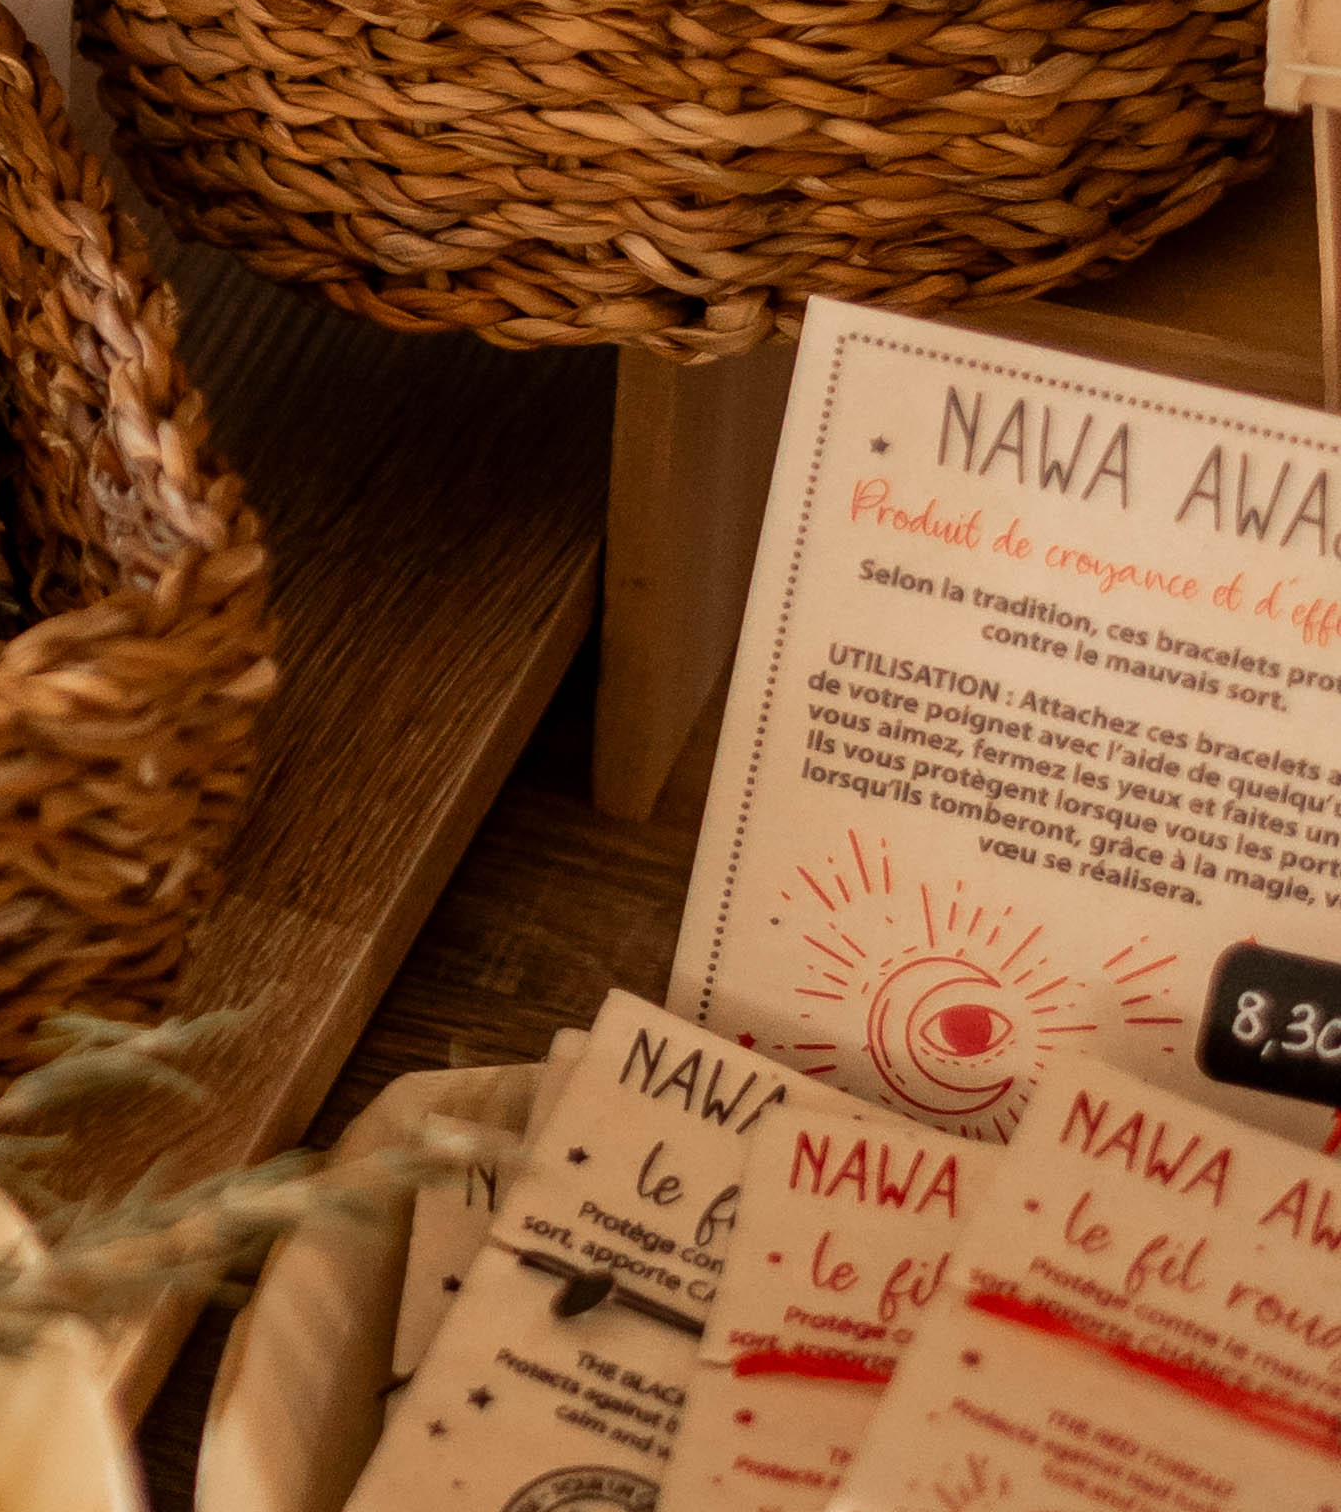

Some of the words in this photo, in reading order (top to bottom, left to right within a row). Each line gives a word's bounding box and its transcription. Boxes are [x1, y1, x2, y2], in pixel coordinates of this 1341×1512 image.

[936, 384, 1131, 511] NAWA
[849, 477, 984, 553] Produit
[990, 516, 1033, 560] de
[1043, 543, 1199, 601] croyance
[1211, 570, 1245, 612] et
[857, 557, 935, 596] Selon
[940, 575, 966, 604] la
[971, 586, 1099, 638] tradition,
[1105, 623, 1149, 648] ces
[1154, 628, 1281, 680] bracelets
[980, 623, 1069, 660] contre
[1073, 639, 1100, 667] le
[1103, 653, 1220, 696] mauvais
[1225, 682, 1288, 713] sort.
[806, 669, 842, 697] de
[847, 681, 920, 715] votre
[923, 701, 1034, 743] poignet
[1036, 728, 1101, 759] avec
[1185, 761, 1222, 789] de
[807, 702, 872, 734] vous
[875, 717, 965, 759] aimez,
[971, 736, 1068, 782] fermez
[1071, 761, 1110, 792] les
[1114, 778, 1183, 810] yeux
[1187, 796, 1217, 818] et
[1221, 798, 1302, 839] faites
[827, 641, 1001, 704] UTILISATION
[1017, 689, 1141, 739] Attachez
[1145, 725, 1189, 750] ces
[1194, 730, 1321, 782] bracelets
[805, 728, 836, 756] Ils
[842, 741, 907, 773] vous
[909, 759, 1050, 808] protègent
[1053, 787, 1159, 835] lorsque
[1164, 820, 1229, 852] vous
[1234, 832, 1274, 863] les
[929, 790, 1083, 849] tomberont,
[1088, 834, 1165, 868] grâce
[1169, 848, 1187, 873] à
[1192, 852, 1218, 880] la
[1222, 864, 1315, 907] magie,
[977, 834, 1038, 866] vœu
[1041, 852, 1074, 875] se
[1077, 853, 1203, 907] réalisera.
[634, 1140, 685, 1207] le
[789, 1129, 959, 1219] NAWA
[1057, 1088, 1233, 1209] NAWA
[579, 1199, 677, 1256] Protège
[812, 1230, 859, 1293] le
[1063, 1190, 1112, 1254] le
